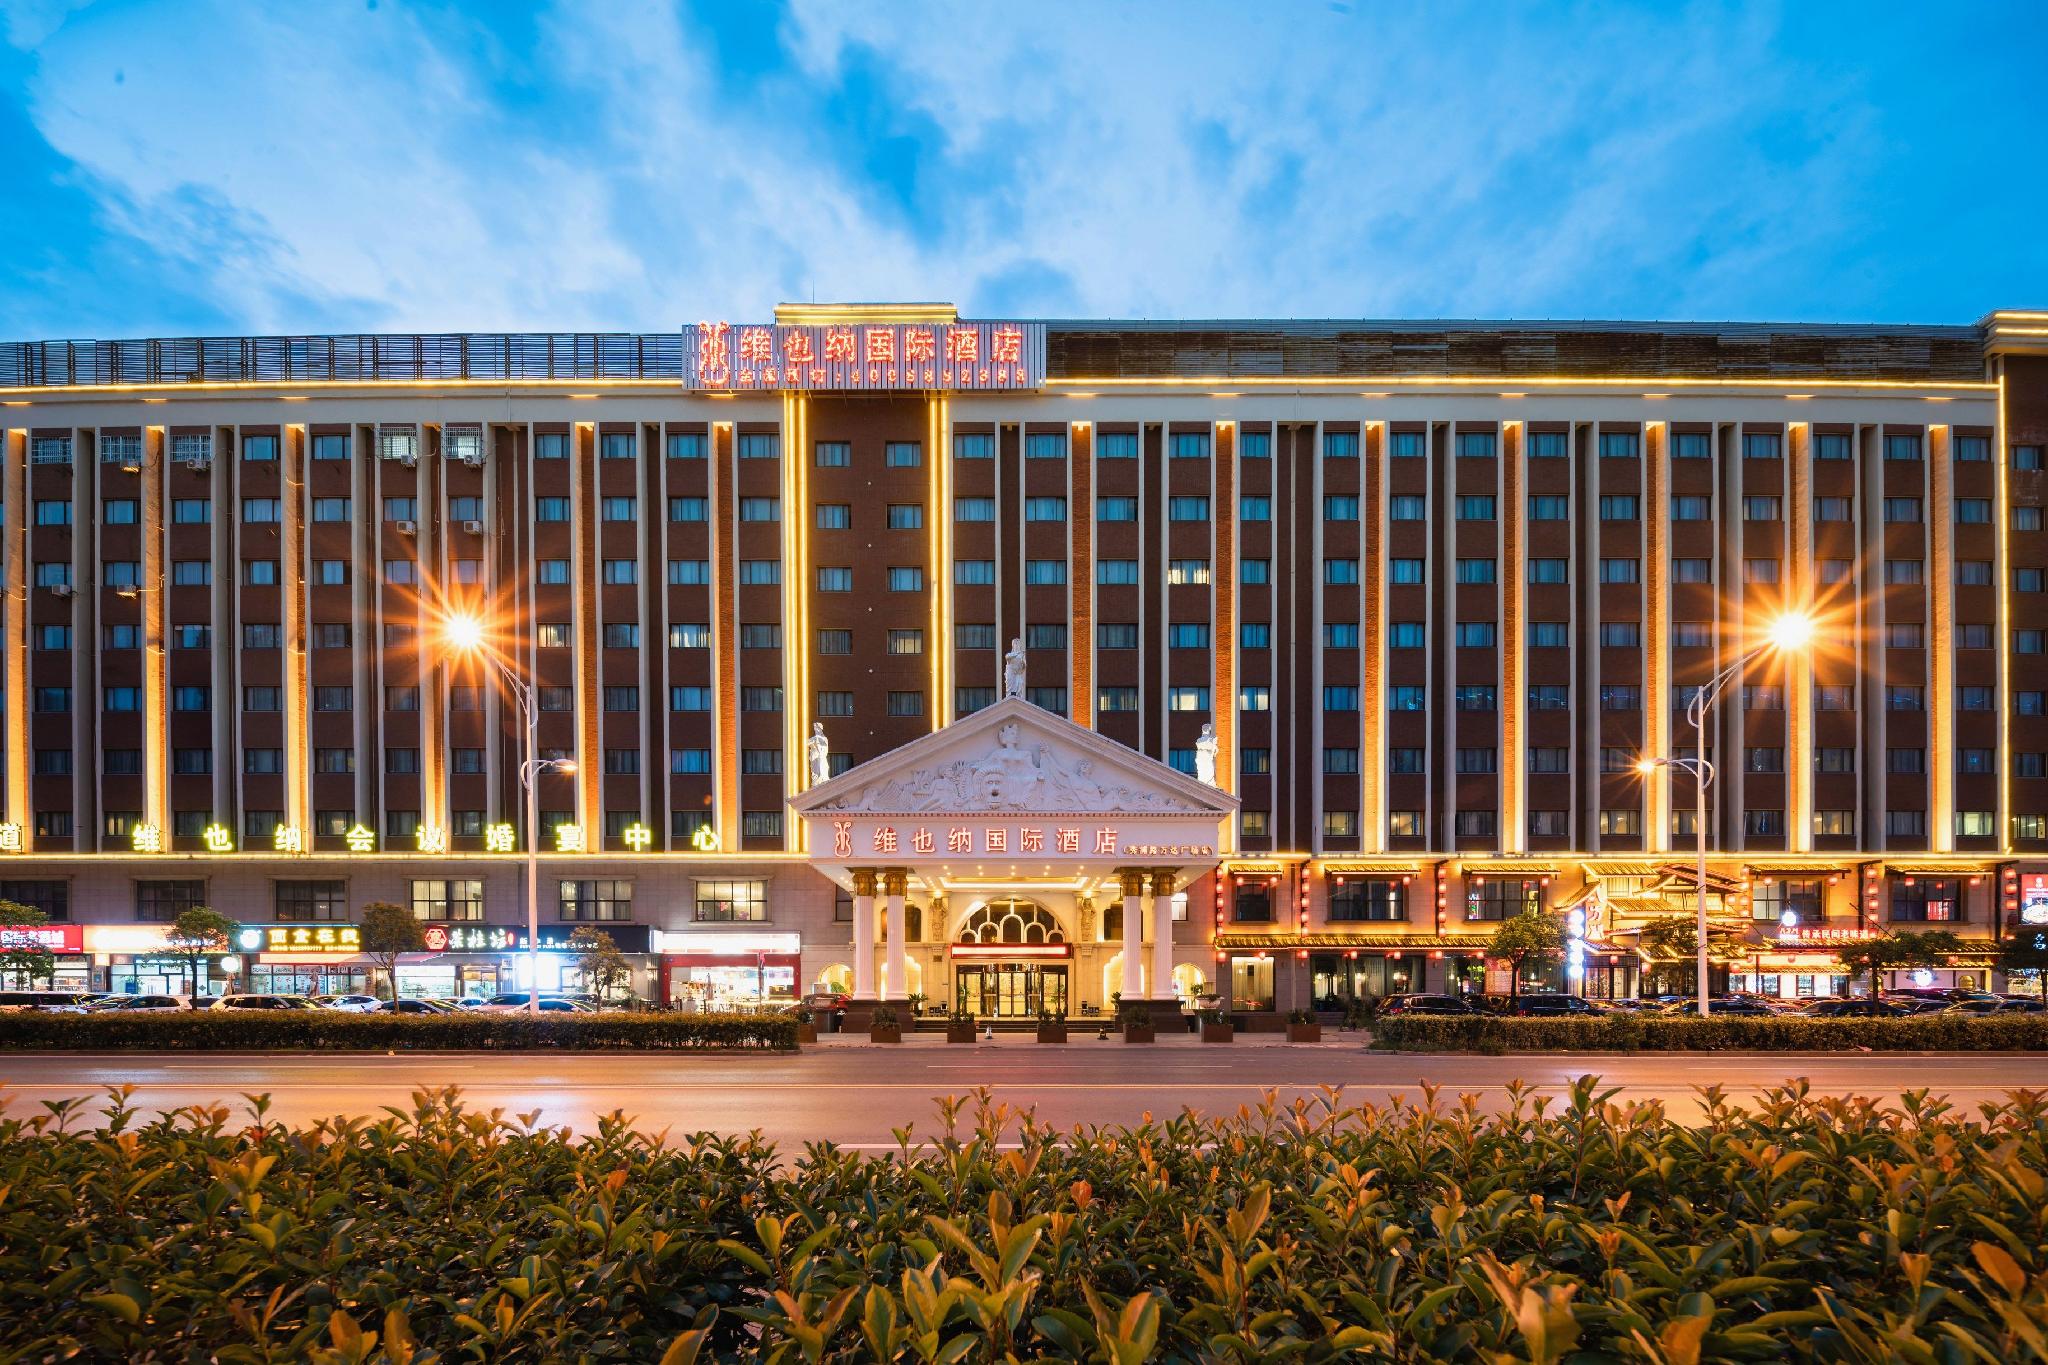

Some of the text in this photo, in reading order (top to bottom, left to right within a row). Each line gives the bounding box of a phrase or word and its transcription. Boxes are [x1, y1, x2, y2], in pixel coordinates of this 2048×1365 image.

[740, 328, 1022, 362] 维也纳国际酒店
[133, 822, 720, 852] 维也纳会议婚宴中心
[873, 827, 1119, 855] 维也纳国际酒店
